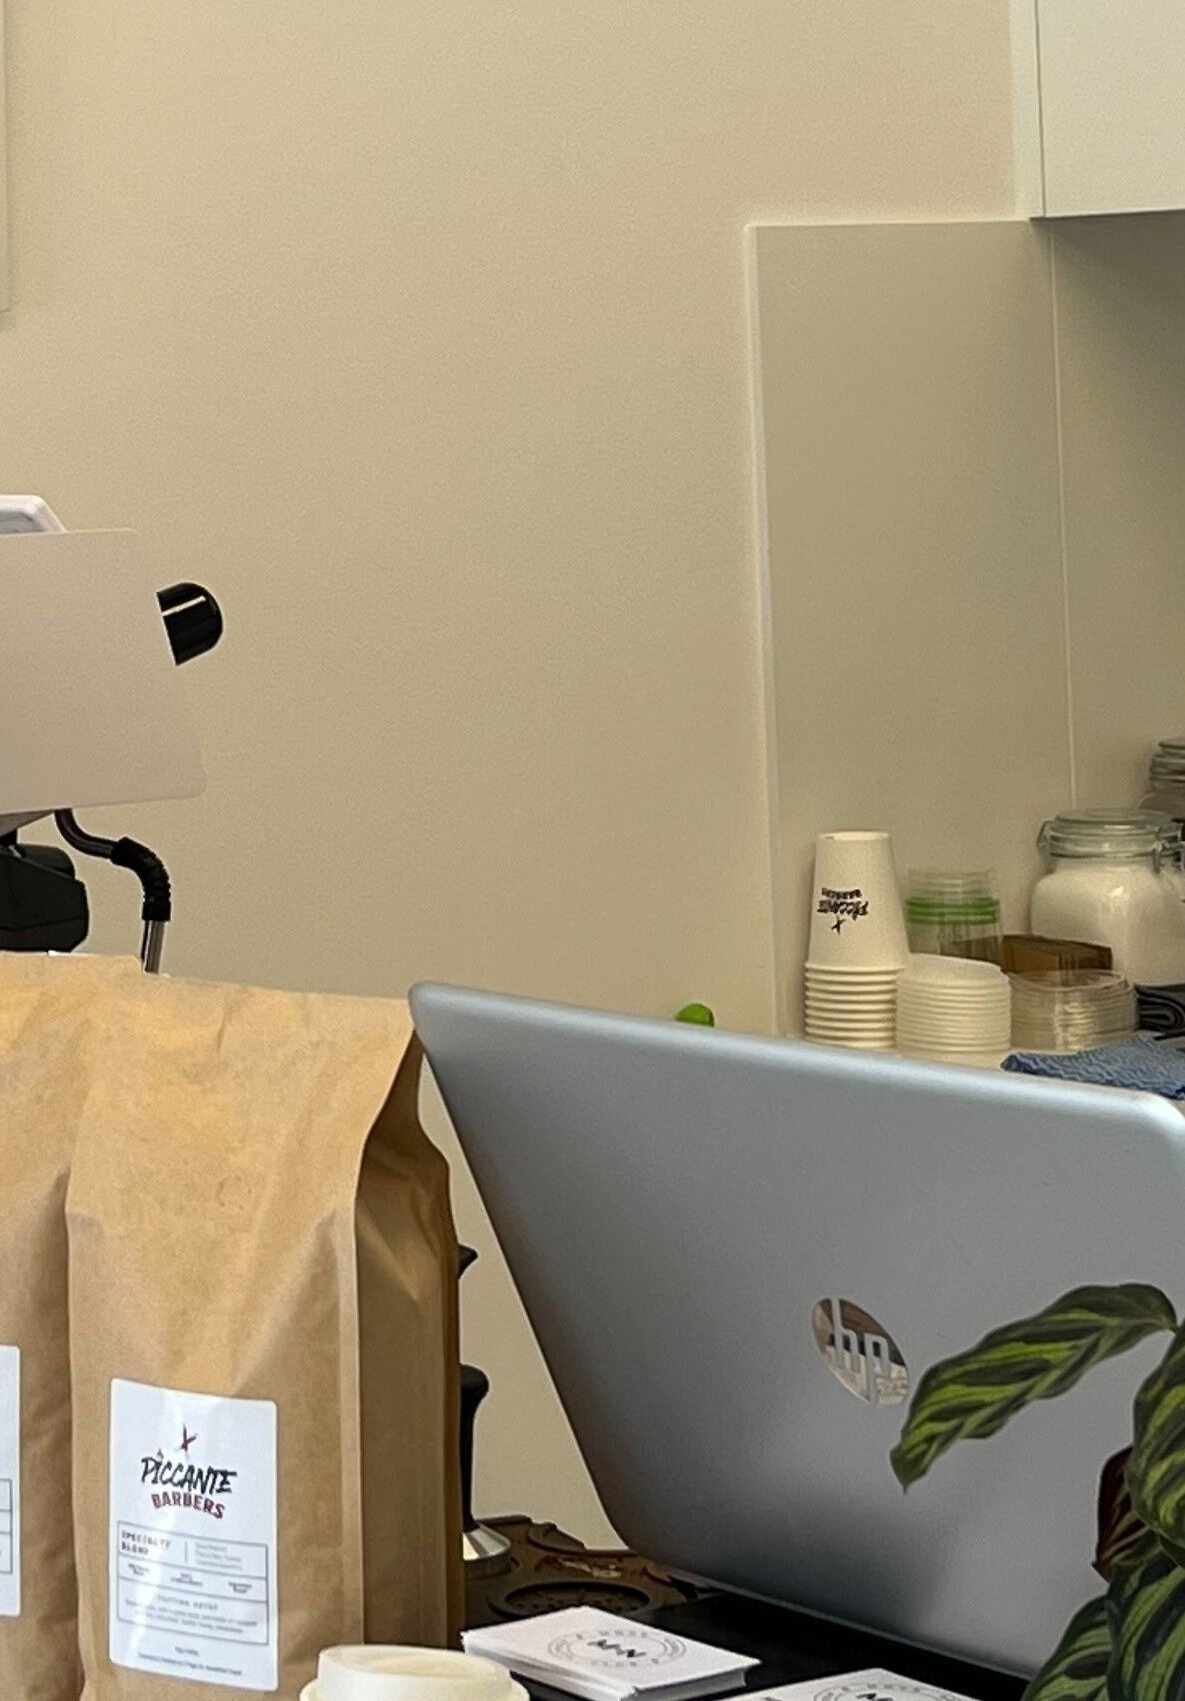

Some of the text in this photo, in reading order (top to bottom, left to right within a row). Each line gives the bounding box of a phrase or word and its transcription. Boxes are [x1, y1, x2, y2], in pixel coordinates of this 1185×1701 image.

[825, 1298, 895, 1405] hp
[141, 1449, 238, 1495] PICCANTE
[151, 1491, 226, 1519] BARBERS
